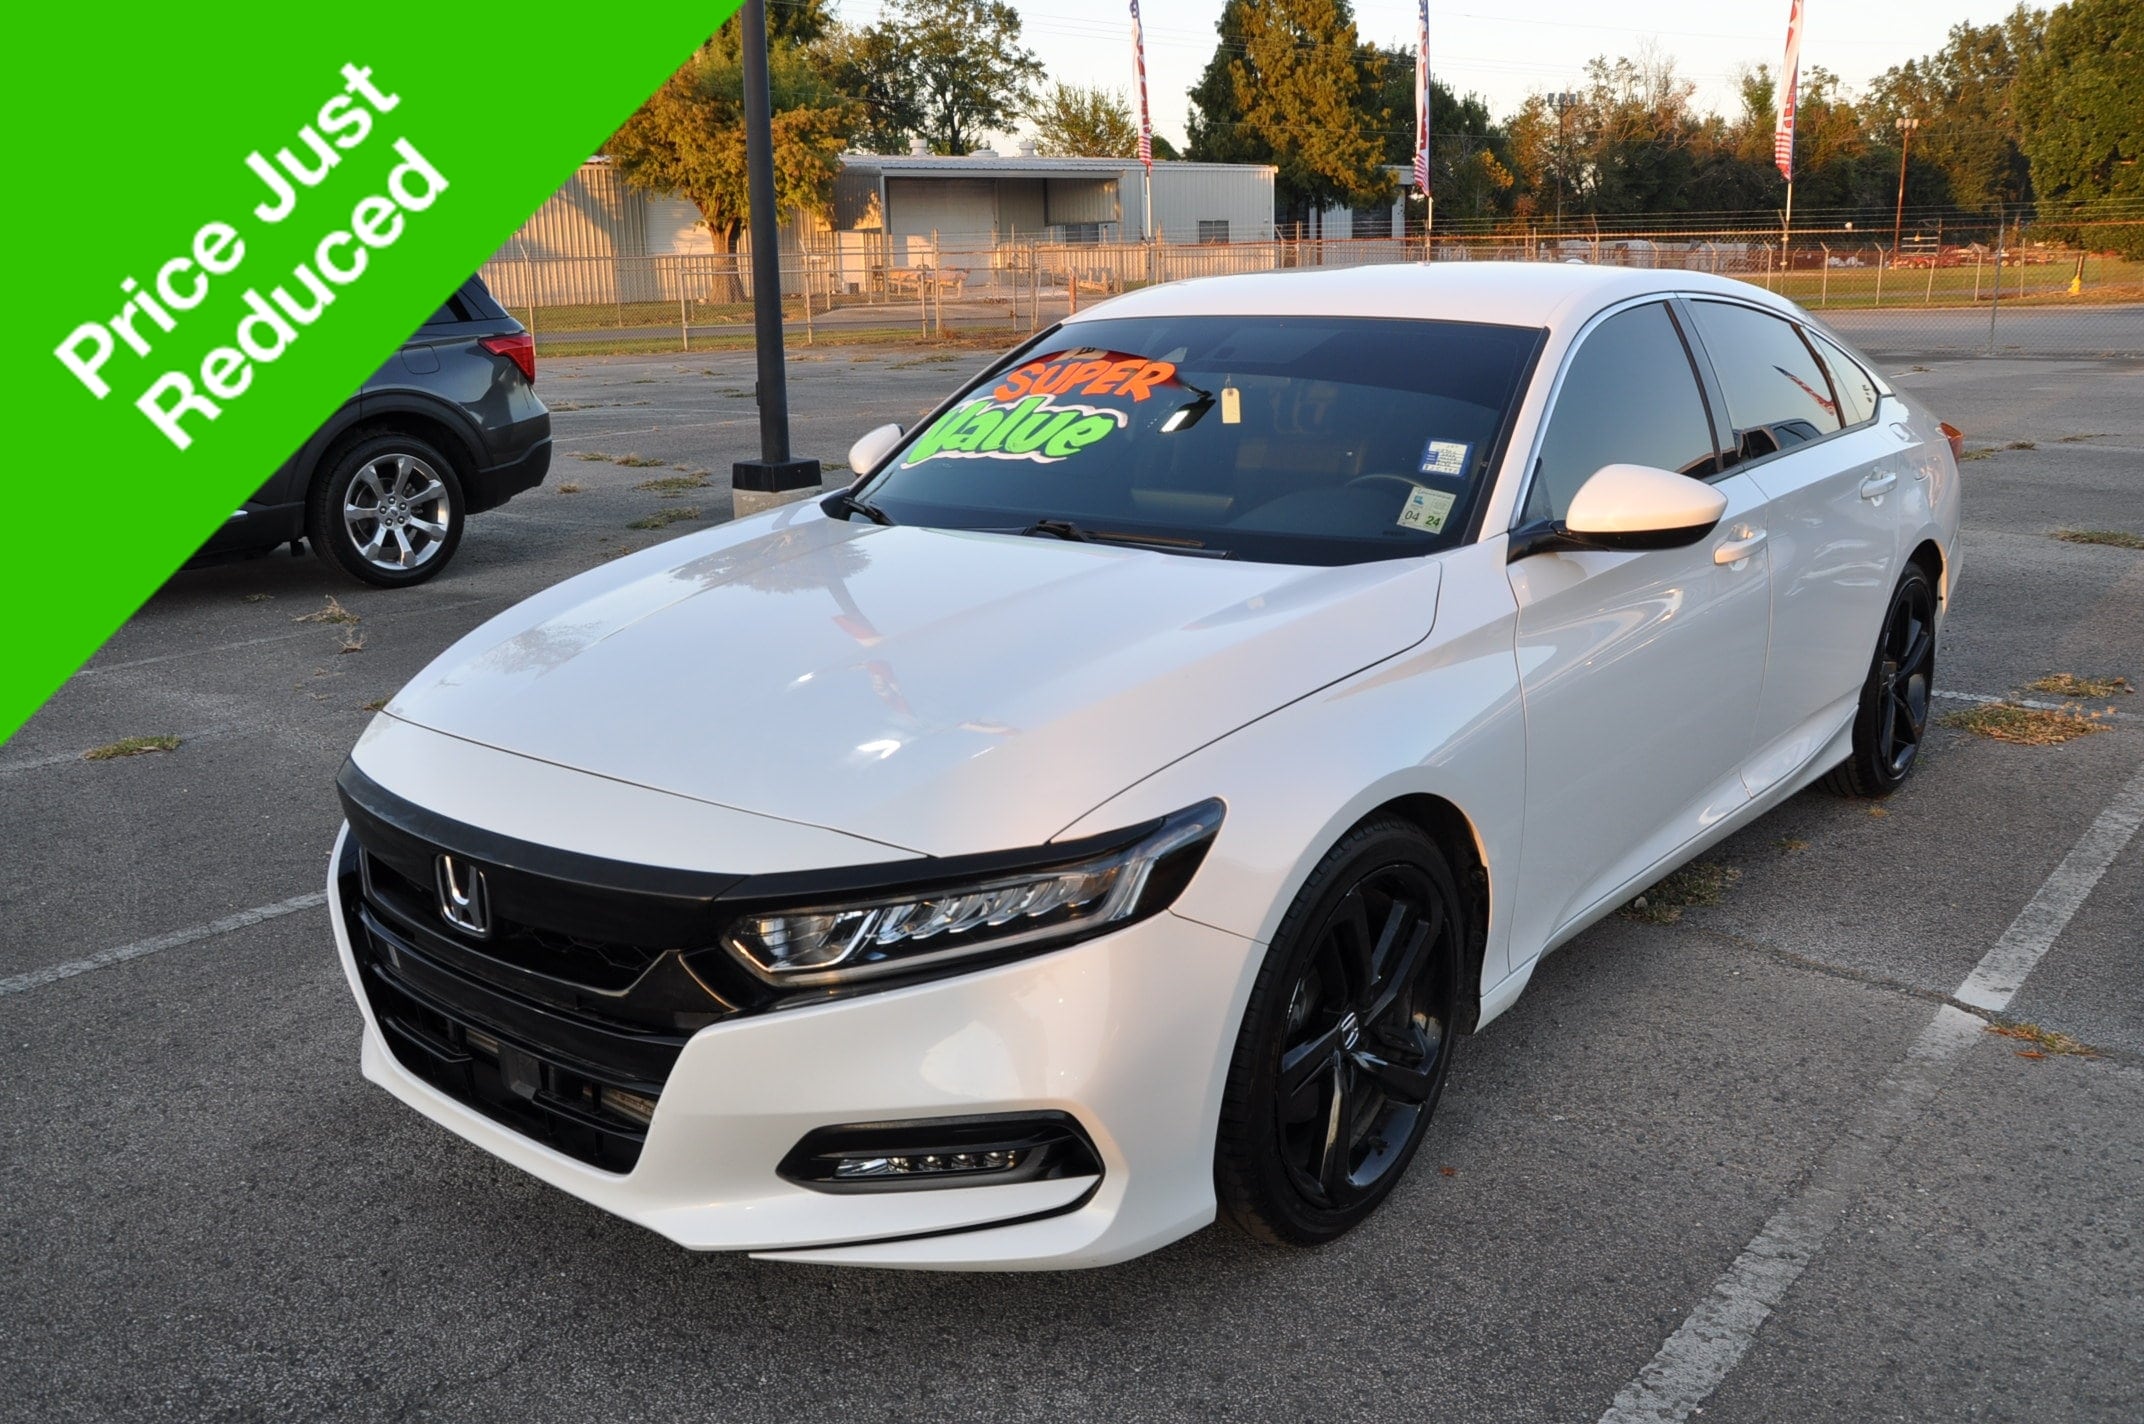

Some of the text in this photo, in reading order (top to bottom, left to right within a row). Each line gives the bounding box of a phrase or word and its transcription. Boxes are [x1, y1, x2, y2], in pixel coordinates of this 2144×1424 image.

[994, 359, 1176, 403] SUPER
[905, 394, 1116, 465] Value
[1405, 511, 1440, 527] 04 24
